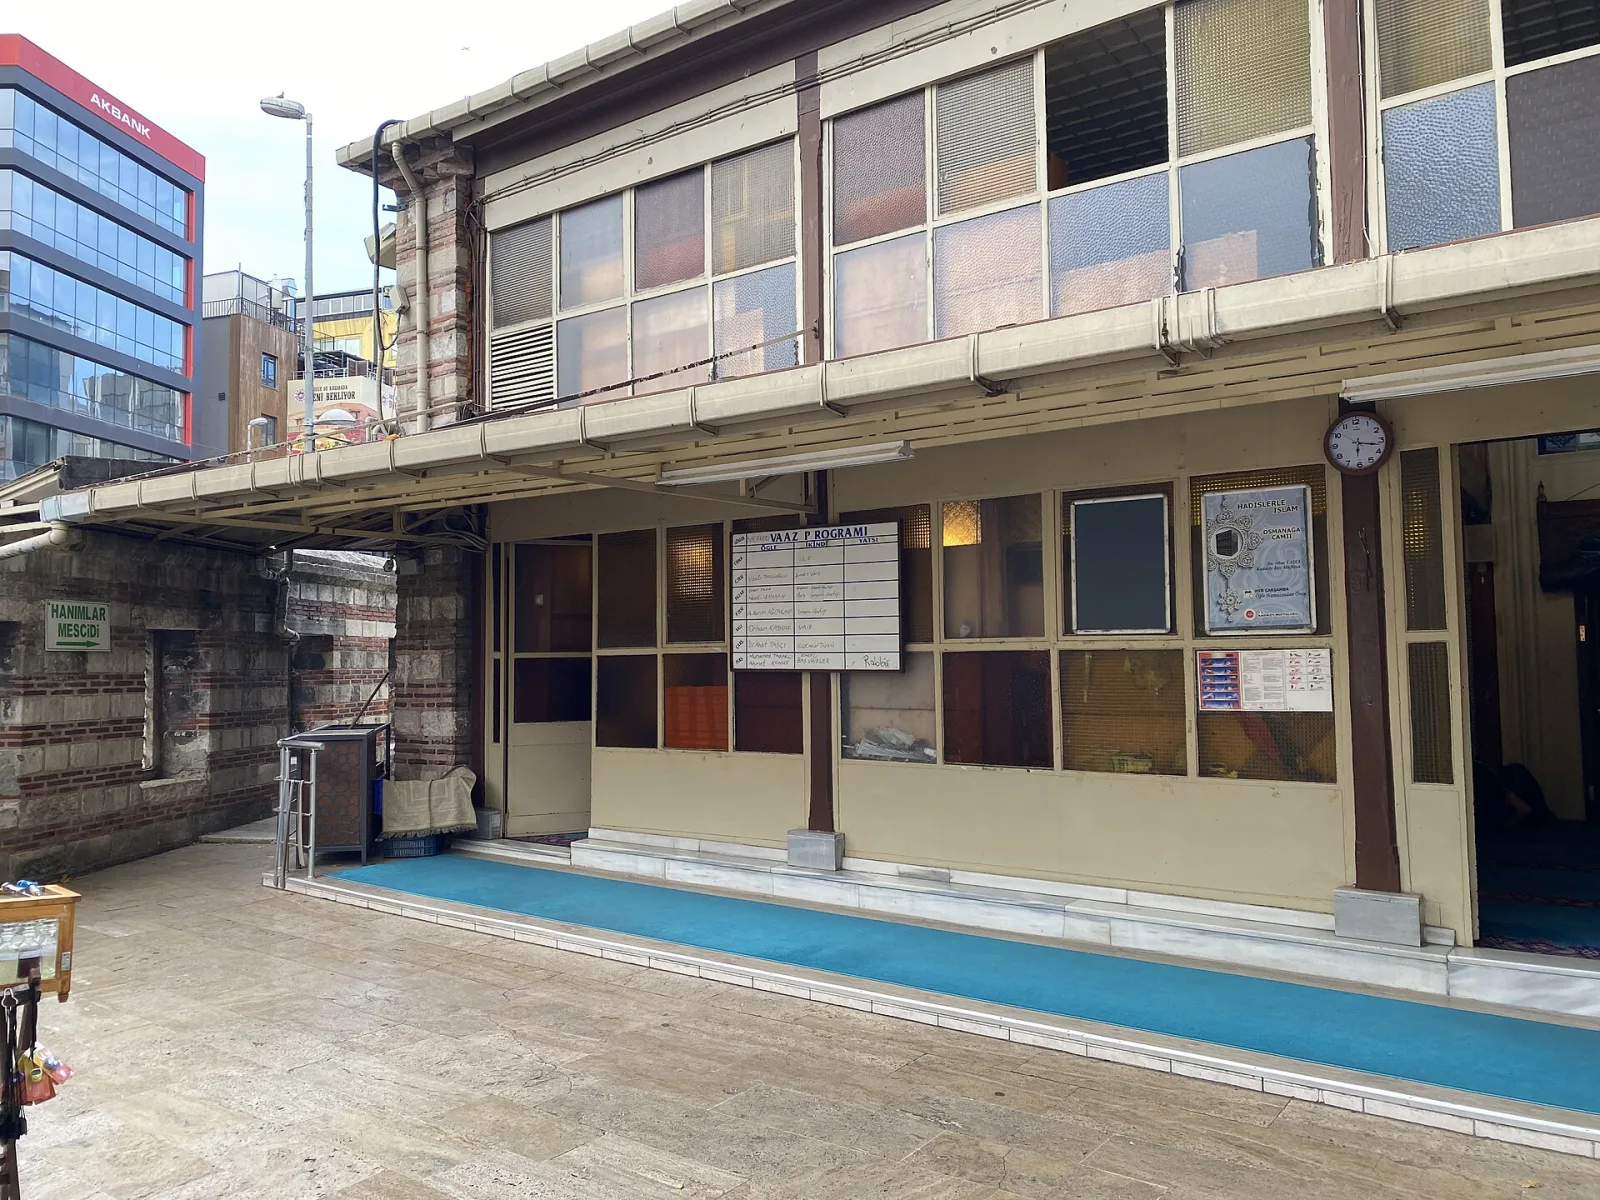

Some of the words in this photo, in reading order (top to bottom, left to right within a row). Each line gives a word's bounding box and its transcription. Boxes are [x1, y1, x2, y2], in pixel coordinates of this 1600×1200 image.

[90, 93, 151, 140] AKBANK
[770, 531, 799, 543] VAAZ
[51, 603, 106, 621] HANIMLAR
